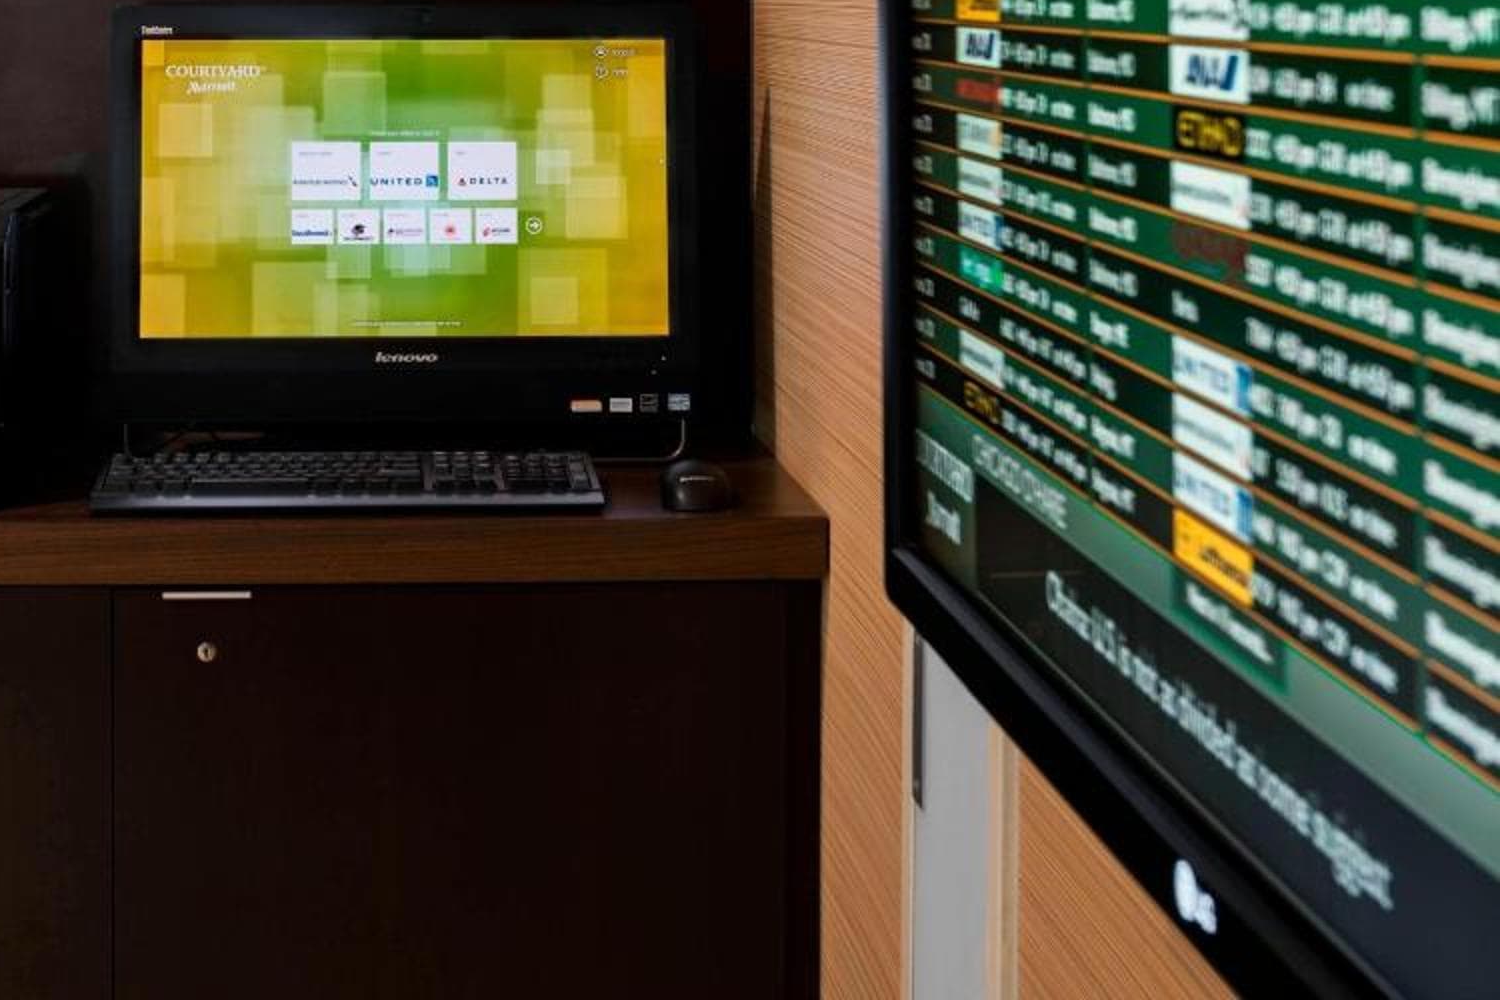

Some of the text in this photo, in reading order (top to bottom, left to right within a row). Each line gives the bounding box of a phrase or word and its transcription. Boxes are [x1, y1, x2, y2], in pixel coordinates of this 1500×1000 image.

[369, 177, 423, 186] UNITED
[469, 177, 508, 186] DELTA
[375, 351, 439, 363] lenovo
